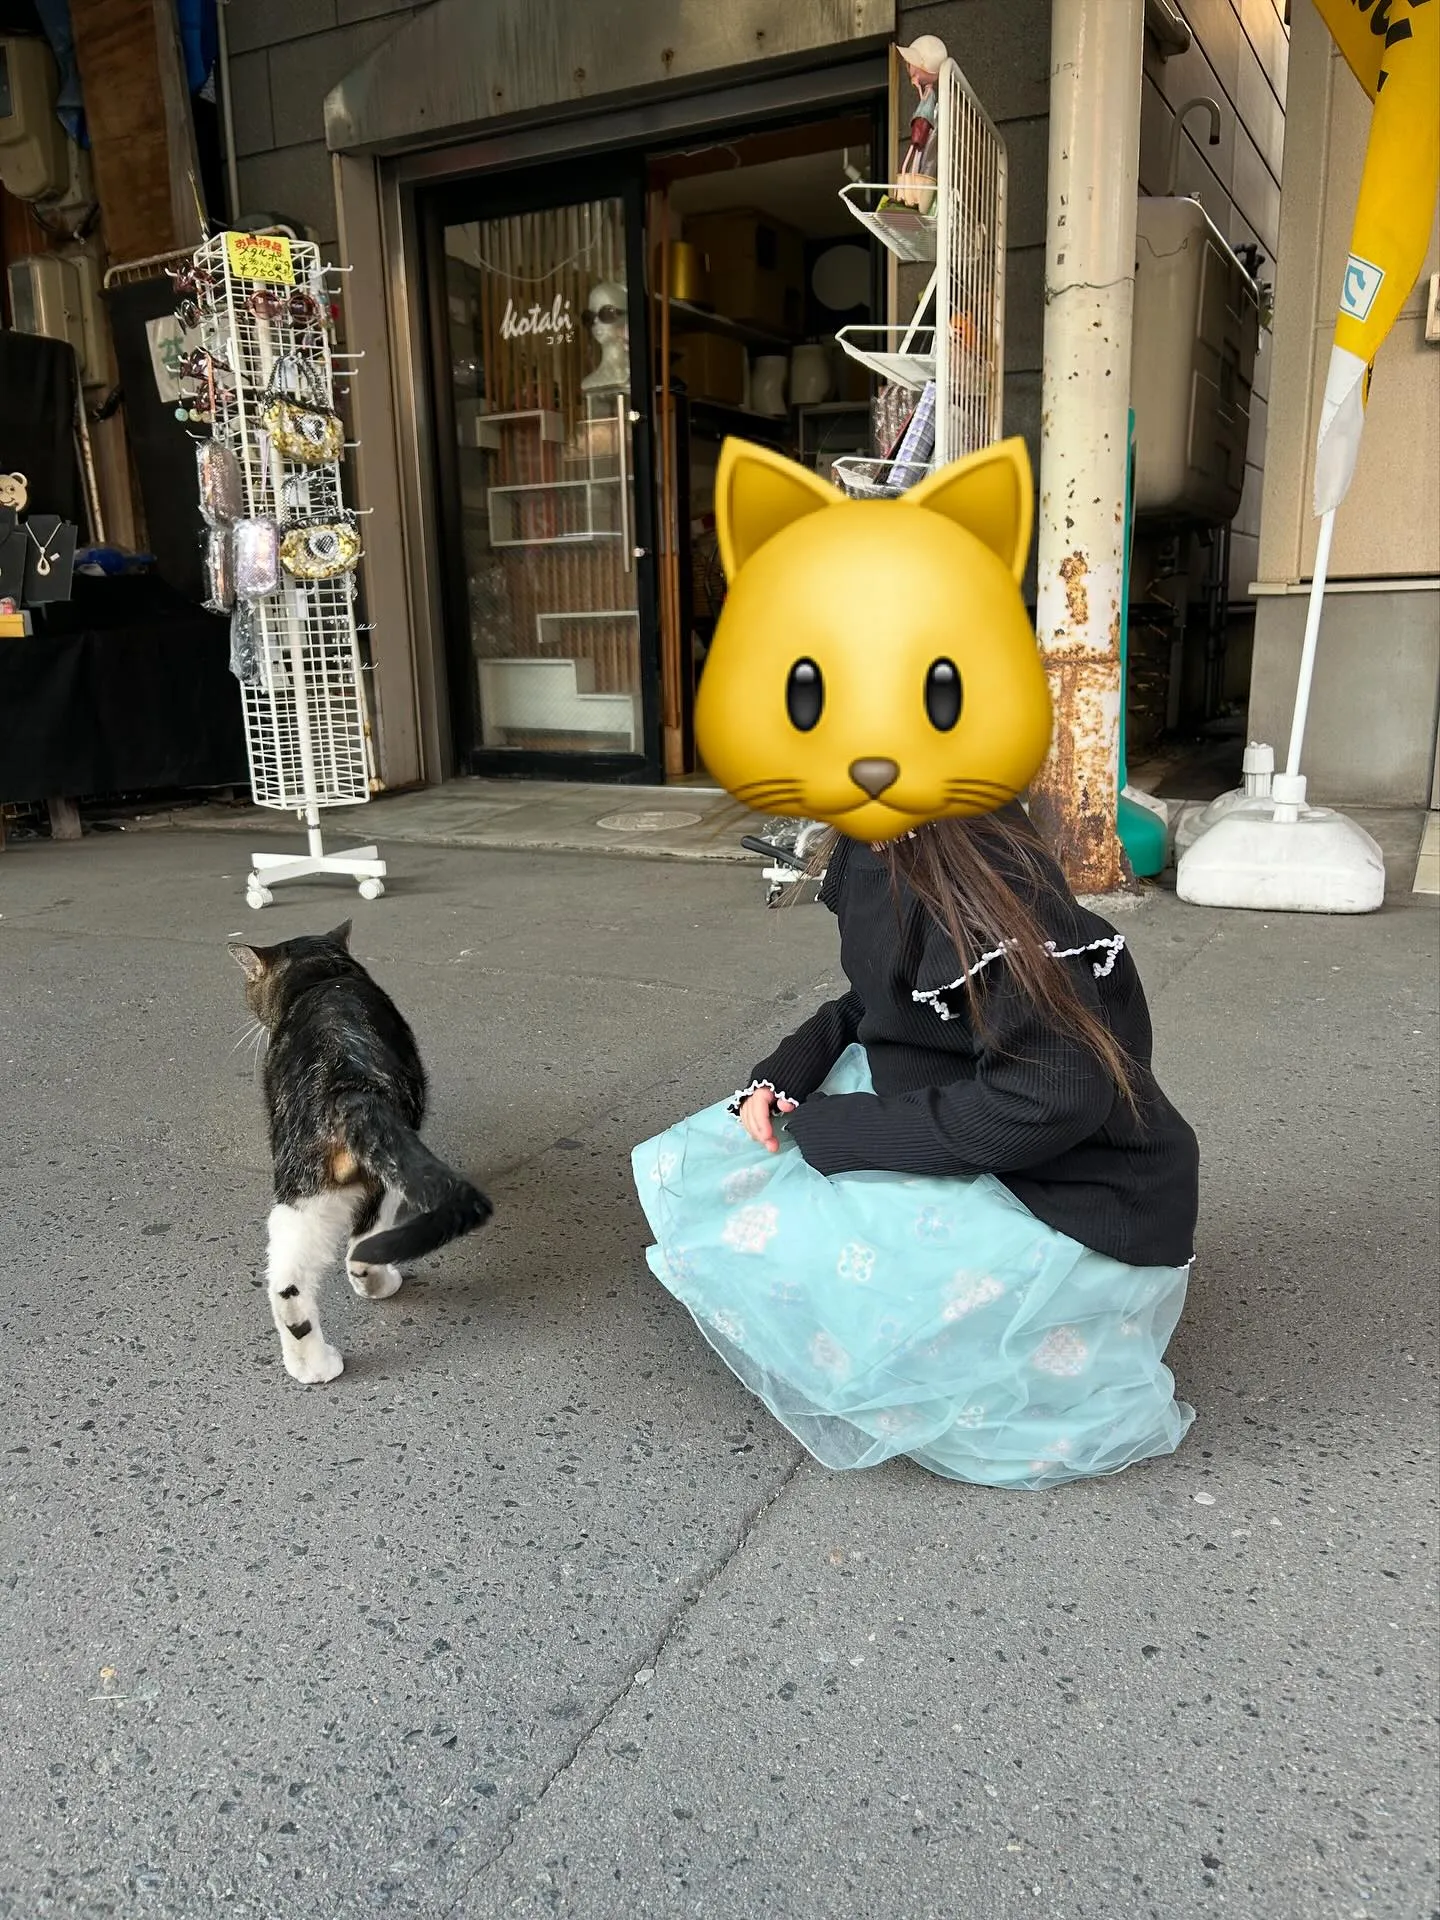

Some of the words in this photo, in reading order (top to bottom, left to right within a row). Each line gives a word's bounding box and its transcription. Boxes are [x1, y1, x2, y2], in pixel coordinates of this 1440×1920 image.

[500, 293, 573, 339] kotabi
[547, 331, 575, 345] コタビ
